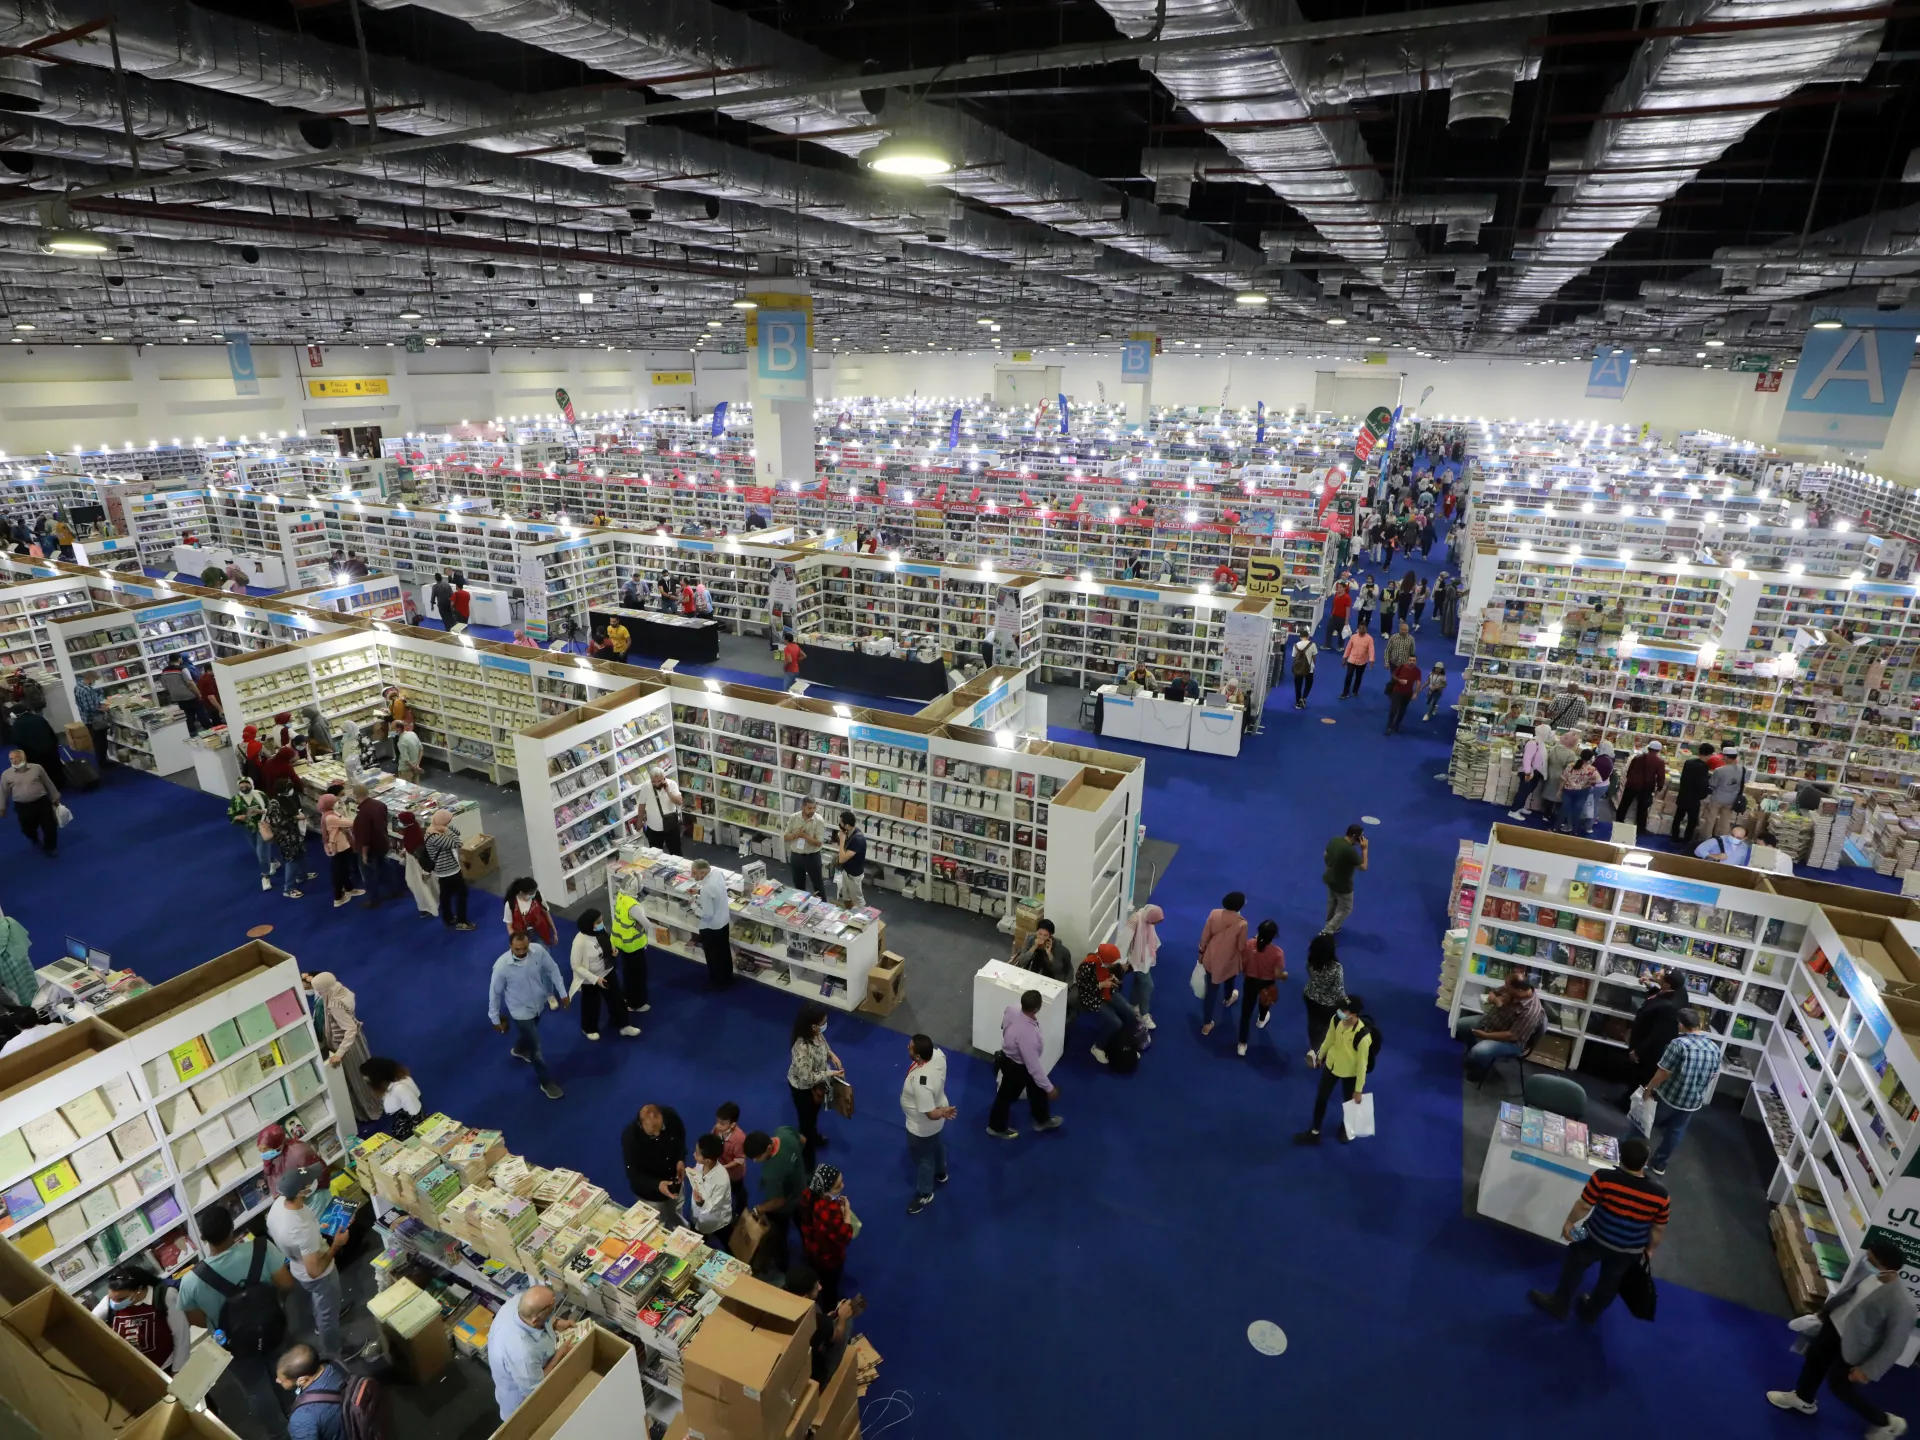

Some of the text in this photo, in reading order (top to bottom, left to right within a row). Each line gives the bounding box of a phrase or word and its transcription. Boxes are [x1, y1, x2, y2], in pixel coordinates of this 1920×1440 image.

[231, 340, 250, 375] C
[768, 321, 797, 371] B
[1128, 345, 1145, 369] B
[1594, 352, 1622, 382] A
[1801, 324, 1885, 404] A
[1249, 581, 1280, 593] دارك
[1595, 868, 1619, 881] A61
